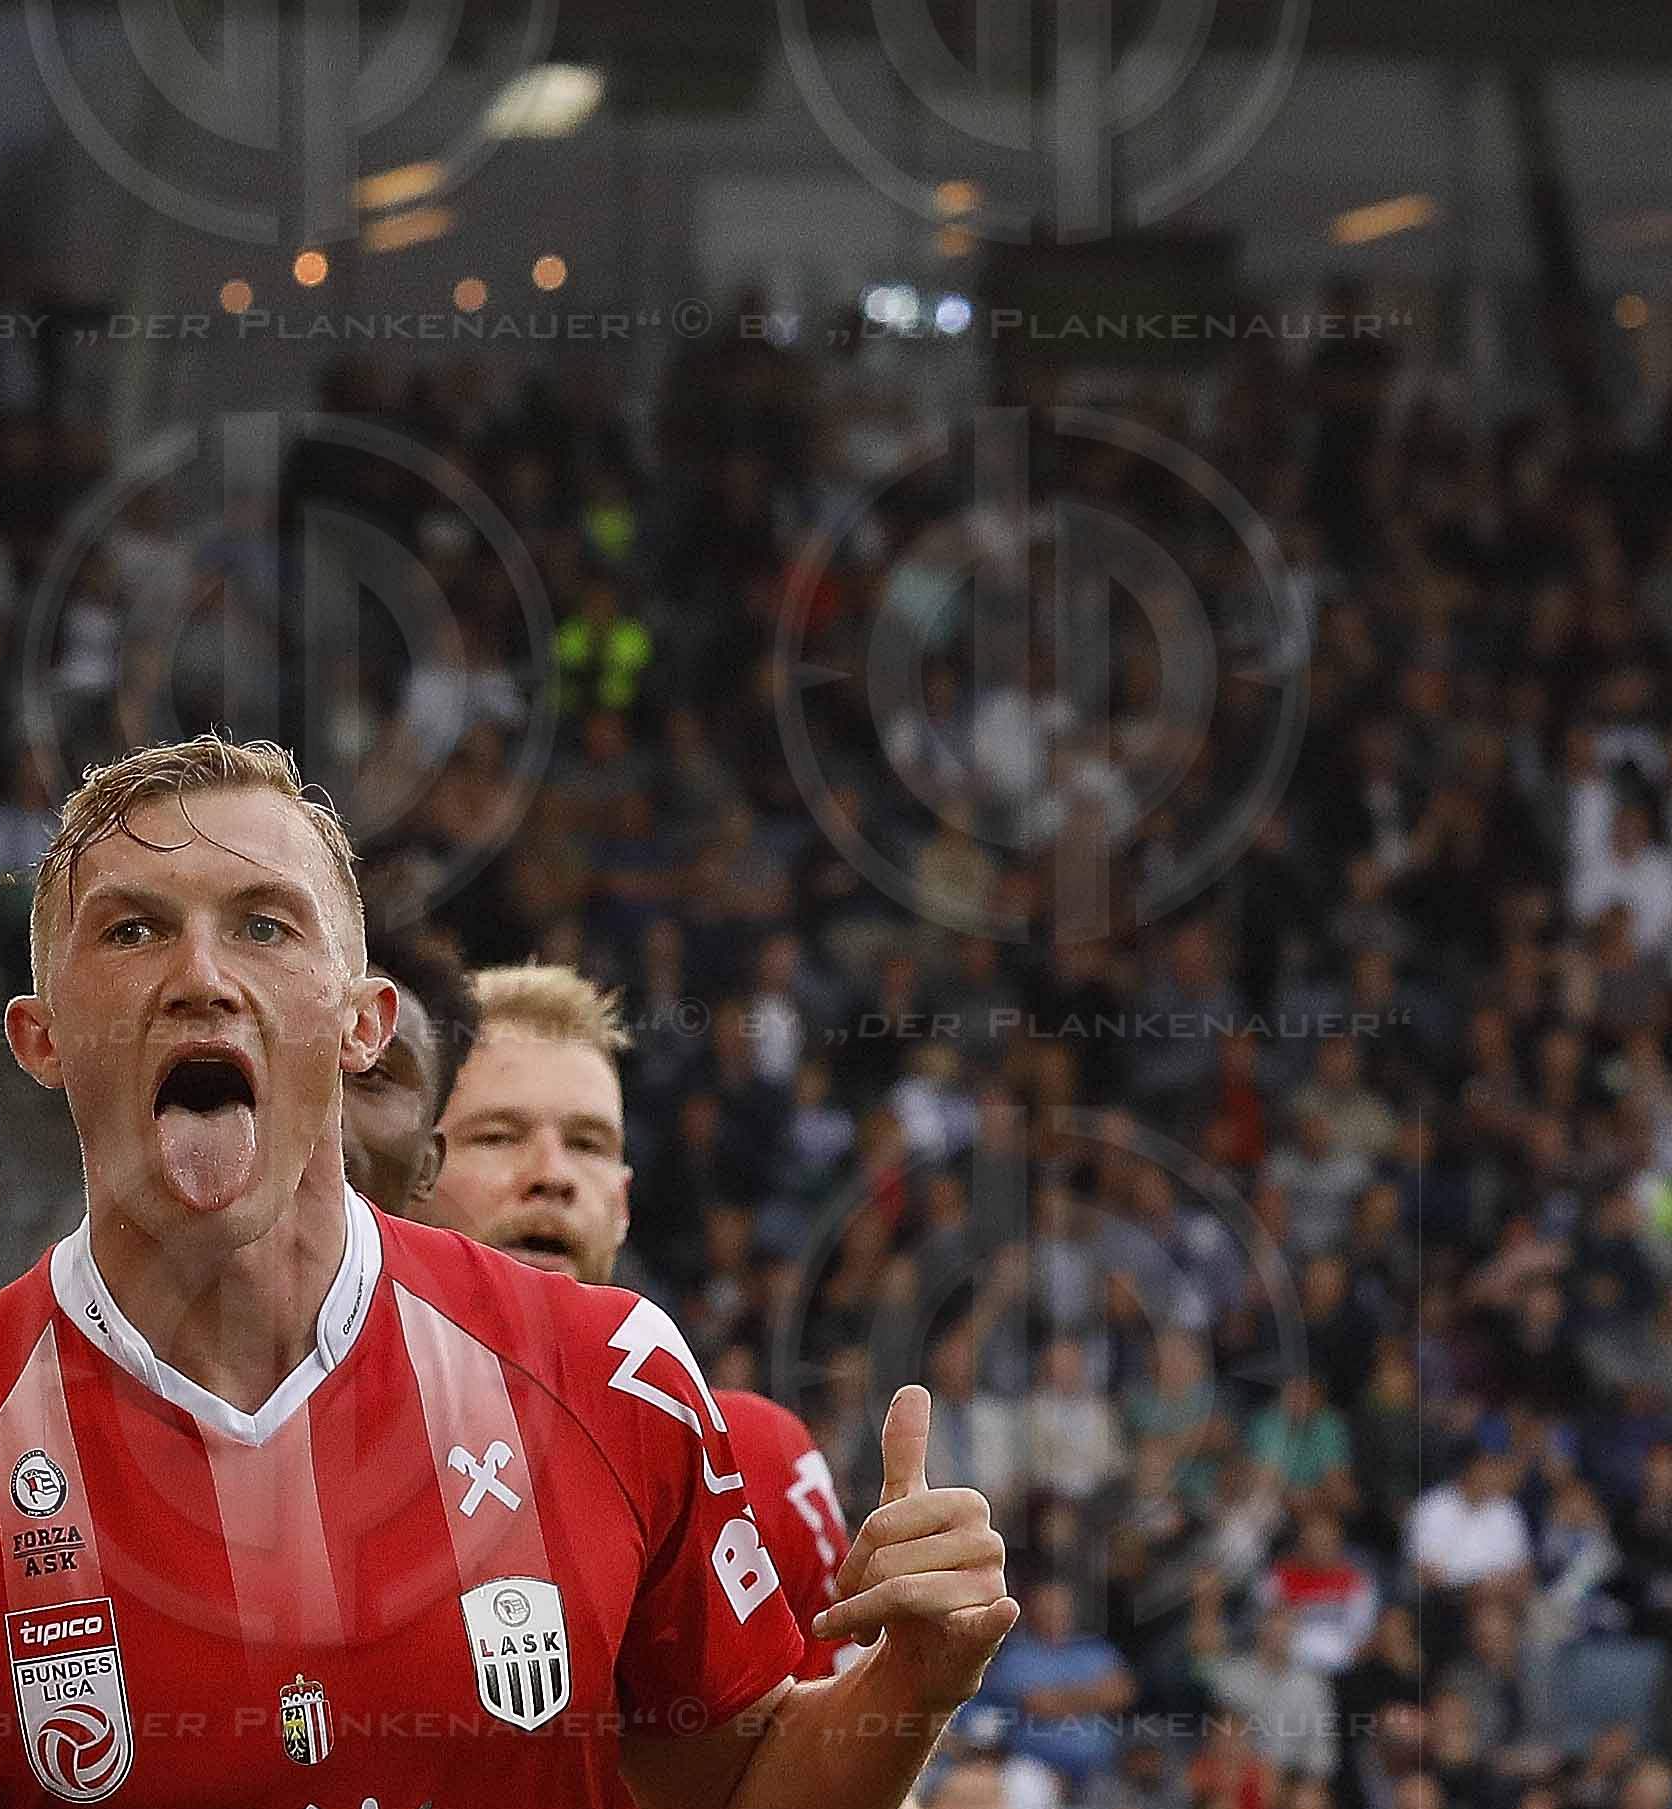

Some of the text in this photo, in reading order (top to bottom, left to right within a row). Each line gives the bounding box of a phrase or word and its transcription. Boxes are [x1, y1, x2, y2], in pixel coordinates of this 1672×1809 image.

[12, 1525, 84, 1553] FORZA
[23, 1551, 79, 1578] ASK
[19, 1614, 103, 1647] tipico
[478, 1630, 562, 1659] LASK
[20, 1656, 114, 1686] BUNDES
[41, 1679, 96, 1703] LIGA
